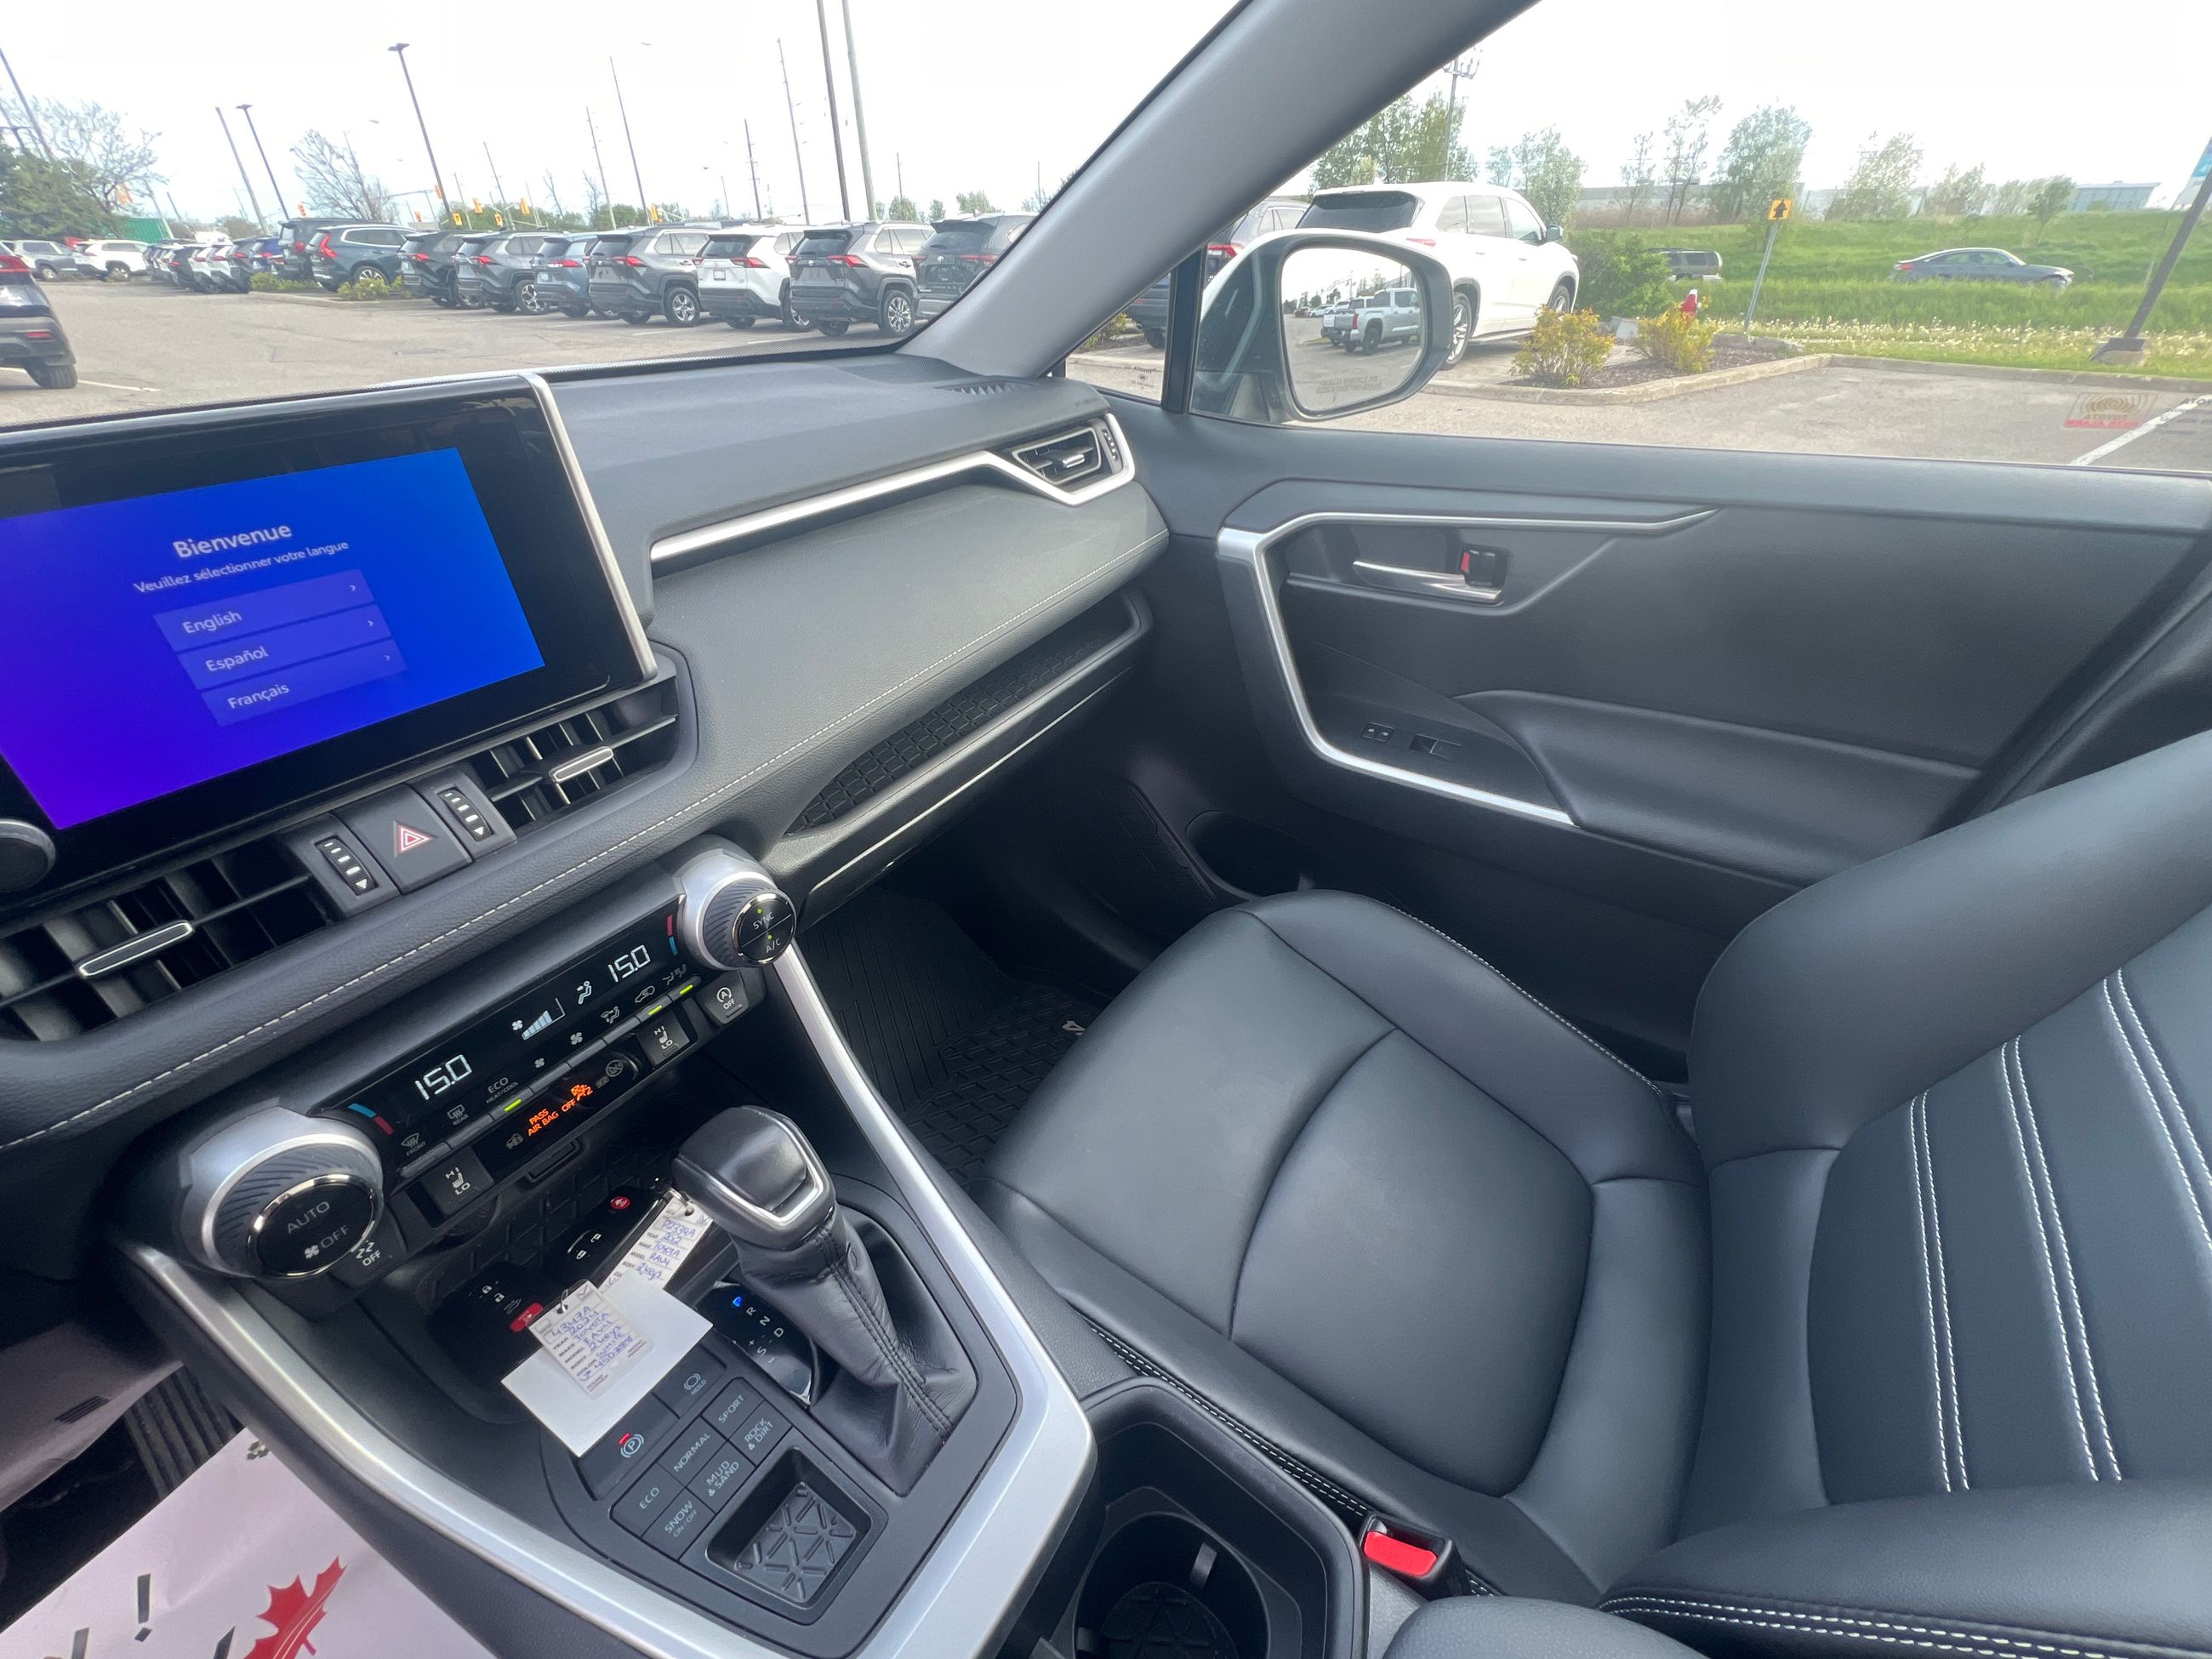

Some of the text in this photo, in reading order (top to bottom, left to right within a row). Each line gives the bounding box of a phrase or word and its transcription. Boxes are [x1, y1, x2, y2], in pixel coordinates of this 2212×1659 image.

[173, 524, 293, 558] Bienvenue
[133, 541, 350, 594] Veuillez sélectionner votre langue
[182, 610, 243, 635] English
[205, 646, 270, 672] Español
[227, 683, 290, 710] Français
[753, 912, 775, 931] SYNC
[765, 938, 782, 954] A/C
[723, 998, 736, 1011] OFF
[653, 1025, 666, 1036] HI
[661, 1039, 674, 1050] LO
[486, 1080, 520, 1104] HEAT/COOL
[487, 1076, 510, 1094] ECO
[527, 1098, 578, 1137] AIR BAG OFF
[528, 1108, 550, 1126] PASS
[405, 1141, 426, 1157] FRONT
[445, 1166, 460, 1180] HI
[454, 1181, 471, 1196] LO
[286, 1200, 331, 1235] AUTO
[319, 1223, 351, 1250] OFF
[362, 1250, 382, 1268] OFF
[732, 1296, 743, 1307] P
[745, 1306, 756, 1316] R
[573, 1313, 610, 1341] TOYOTA
[759, 1315, 771, 1325] N
[773, 1327, 784, 1337] D
[756, 1346, 767, 1356] S
[691, 1379, 707, 1395] HOLD
[718, 1394, 744, 1423] SPORT
[744, 1418, 768, 1443] ROCK
[747, 1421, 774, 1451] & DIRT
[627, 1441, 635, 1451] P
[673, 1433, 711, 1473] NORMAL
[705, 1460, 731, 1485] MUD
[707, 1461, 739, 1497] & SAND
[639, 1487, 660, 1510] ECO
[664, 1500, 694, 1534] SNOW
[673, 1509, 698, 1537] ON/OFF
